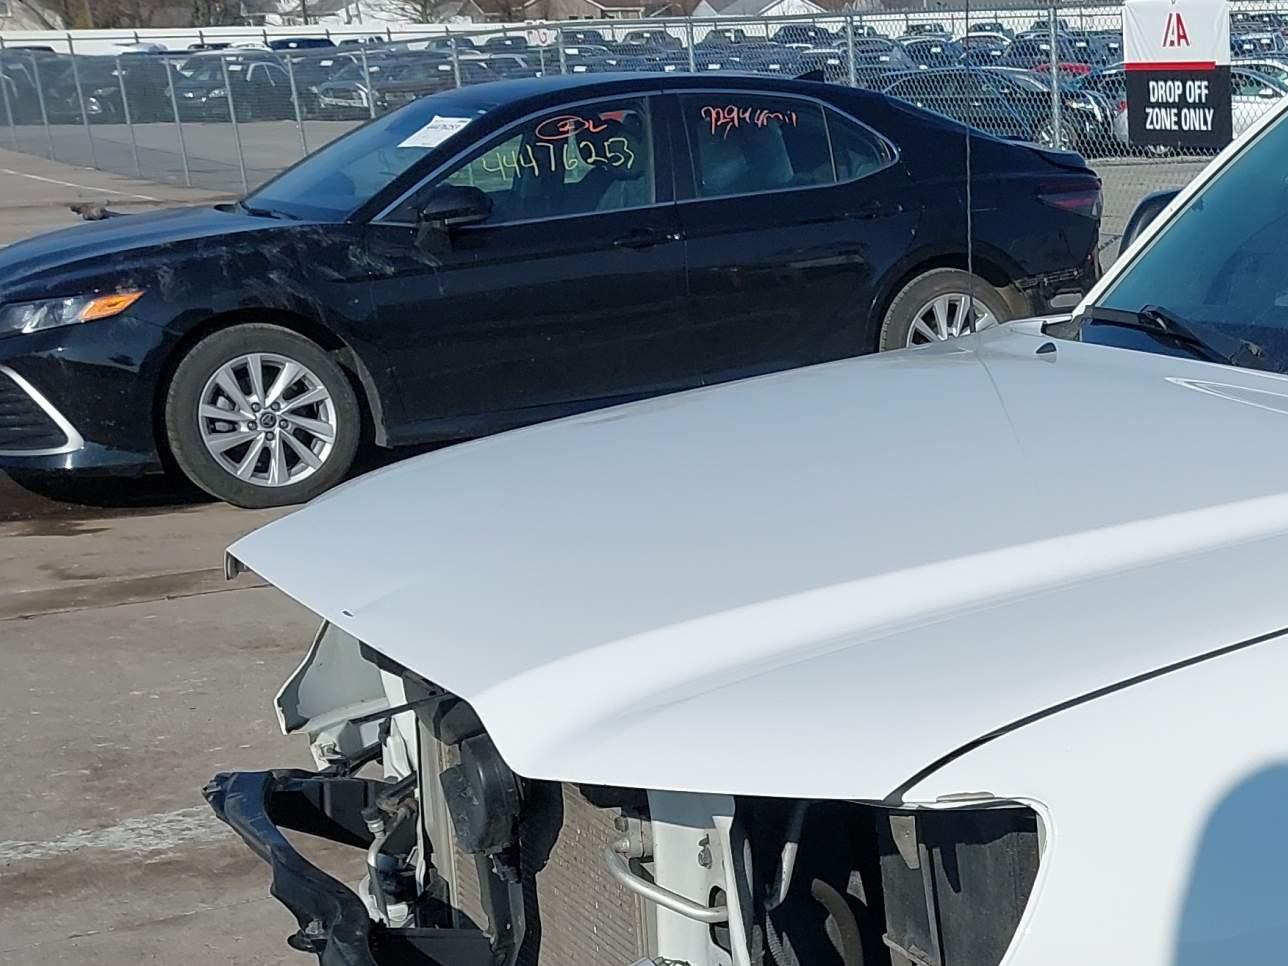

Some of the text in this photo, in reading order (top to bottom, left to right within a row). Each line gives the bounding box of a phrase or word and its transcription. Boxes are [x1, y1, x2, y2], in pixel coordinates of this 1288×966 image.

[1148, 80, 1209, 104] DROP OFF
[1145, 107, 1214, 131] ZONE ONLY
[482, 137, 634, 181] 44476253
